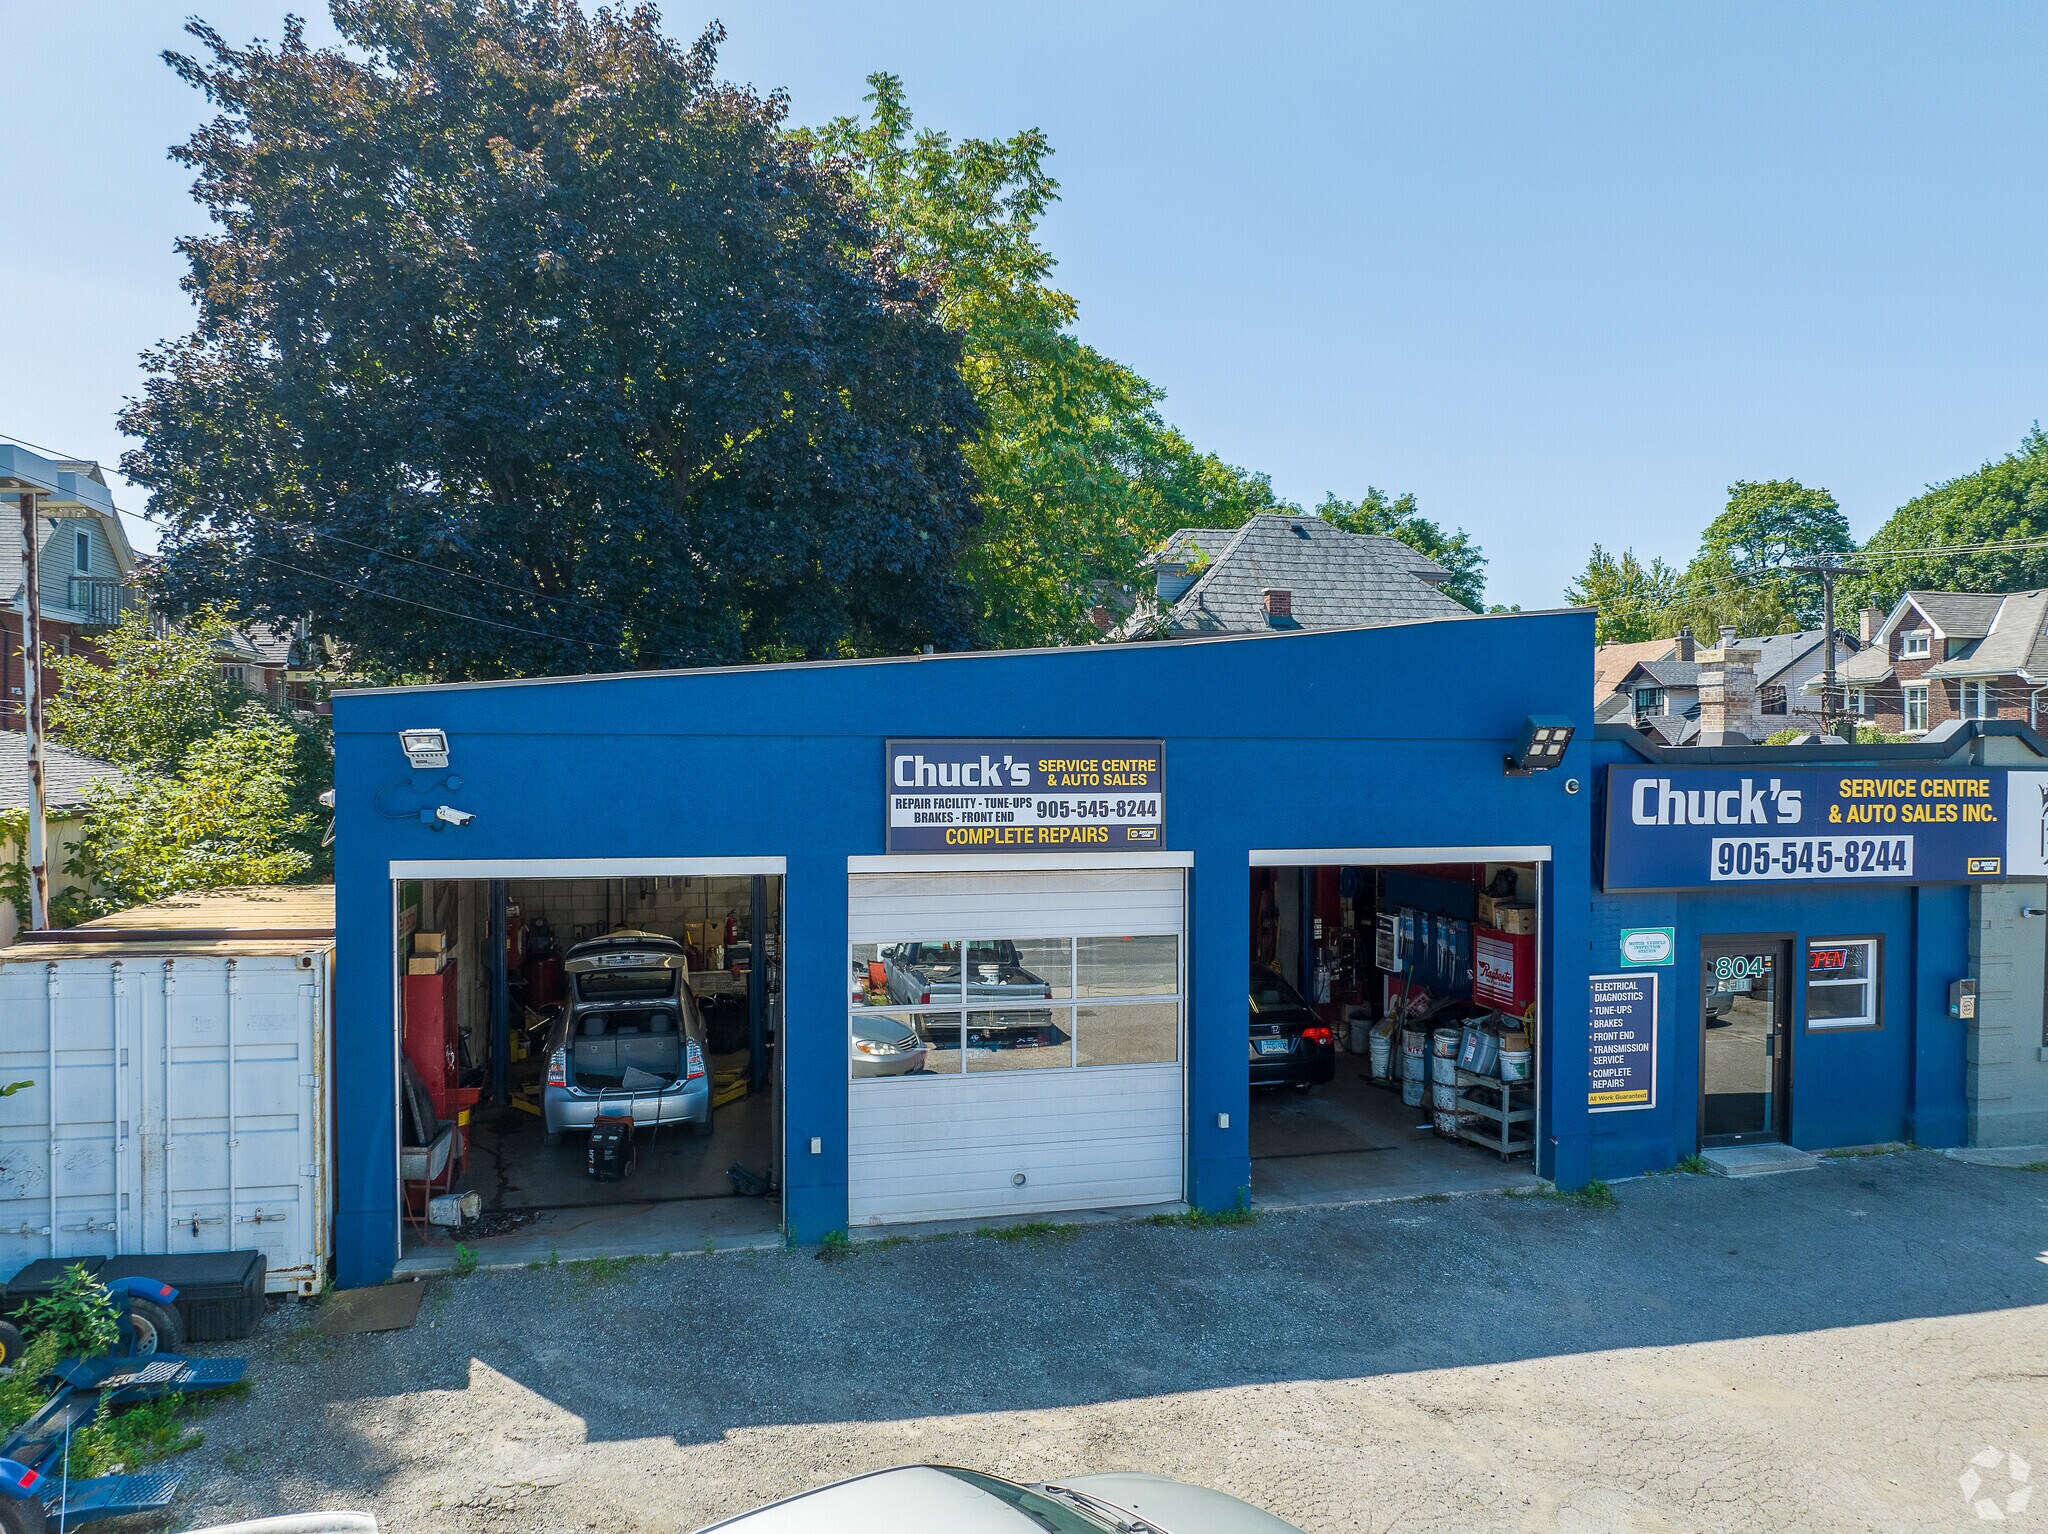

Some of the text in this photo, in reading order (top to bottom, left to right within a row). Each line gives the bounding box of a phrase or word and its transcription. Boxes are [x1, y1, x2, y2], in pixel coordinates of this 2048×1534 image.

[894, 755, 1031, 787] Chuck's
[1038, 759, 1156, 772] SERVICE CENTRE
[1047, 773, 1147, 786] & AUTO SALES
[1839, 779, 1990, 798] SERVICE CENTRE
[895, 798, 931, 810] REPAIR
[933, 797, 977, 809] FACILITY
[984, 796, 1032, 809] TUNE-UPS
[1632, 778, 1802, 825] Chuck's
[1036, 799, 1158, 819] 905-545-8244
[1828, 803, 1998, 823] & AUTO SALES INC.
[914, 812, 953, 824] BRAKES
[961, 811, 993, 823] FRONT
[995, 811, 1015, 823] END
[945, 826, 1109, 845] COMPLETE REPAIRS
[1717, 840, 1907, 876] 905-545-8244
[1716, 956, 1764, 979] 804
[1595, 981, 1638, 992] ELECTRICAL
[1594, 992, 1643, 1003] DIAGNOSTICS
[1594, 1005, 1632, 1016] TUNE-UPS
[1594, 1019, 1624, 1028] BRAKES
[1594, 1030, 1635, 1042] FRONT END
[1594, 1042, 1649, 1054] TRANSMISSION
[1593, 1055, 1624, 1065] SERVICE
[1593, 1067, 1632, 1078] COMPLETE
[1592, 1078, 1625, 1089] REPAIRS
[1615, 1092, 1647, 1100] Guaranteed
